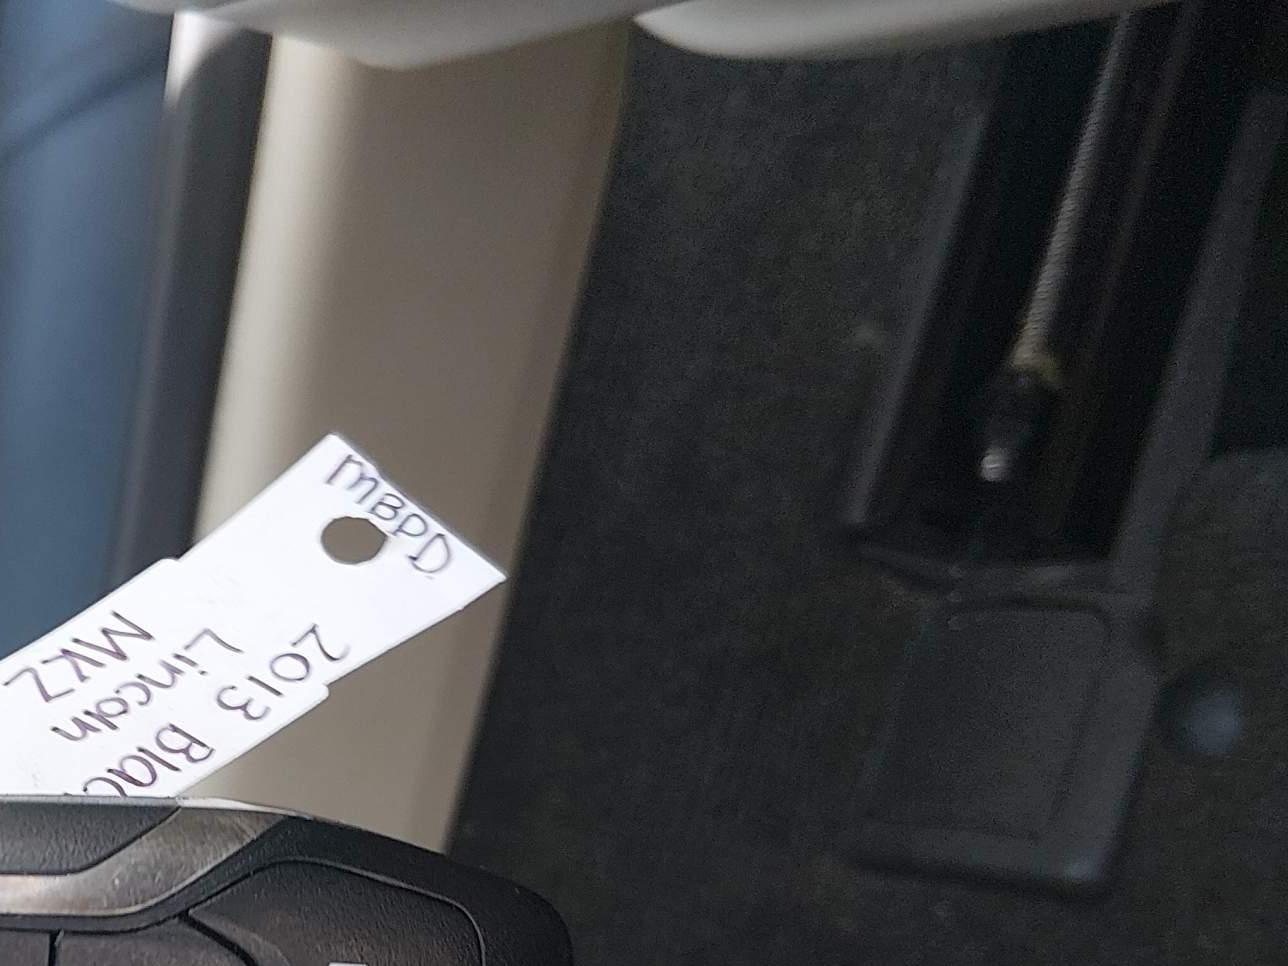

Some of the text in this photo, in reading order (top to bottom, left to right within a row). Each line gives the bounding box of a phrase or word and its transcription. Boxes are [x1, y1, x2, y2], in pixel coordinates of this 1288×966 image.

[3, 611, 154, 702] MKZ
[51, 628, 244, 742] Lincoln
[76, 623, 350, 797] 2013 Blac
